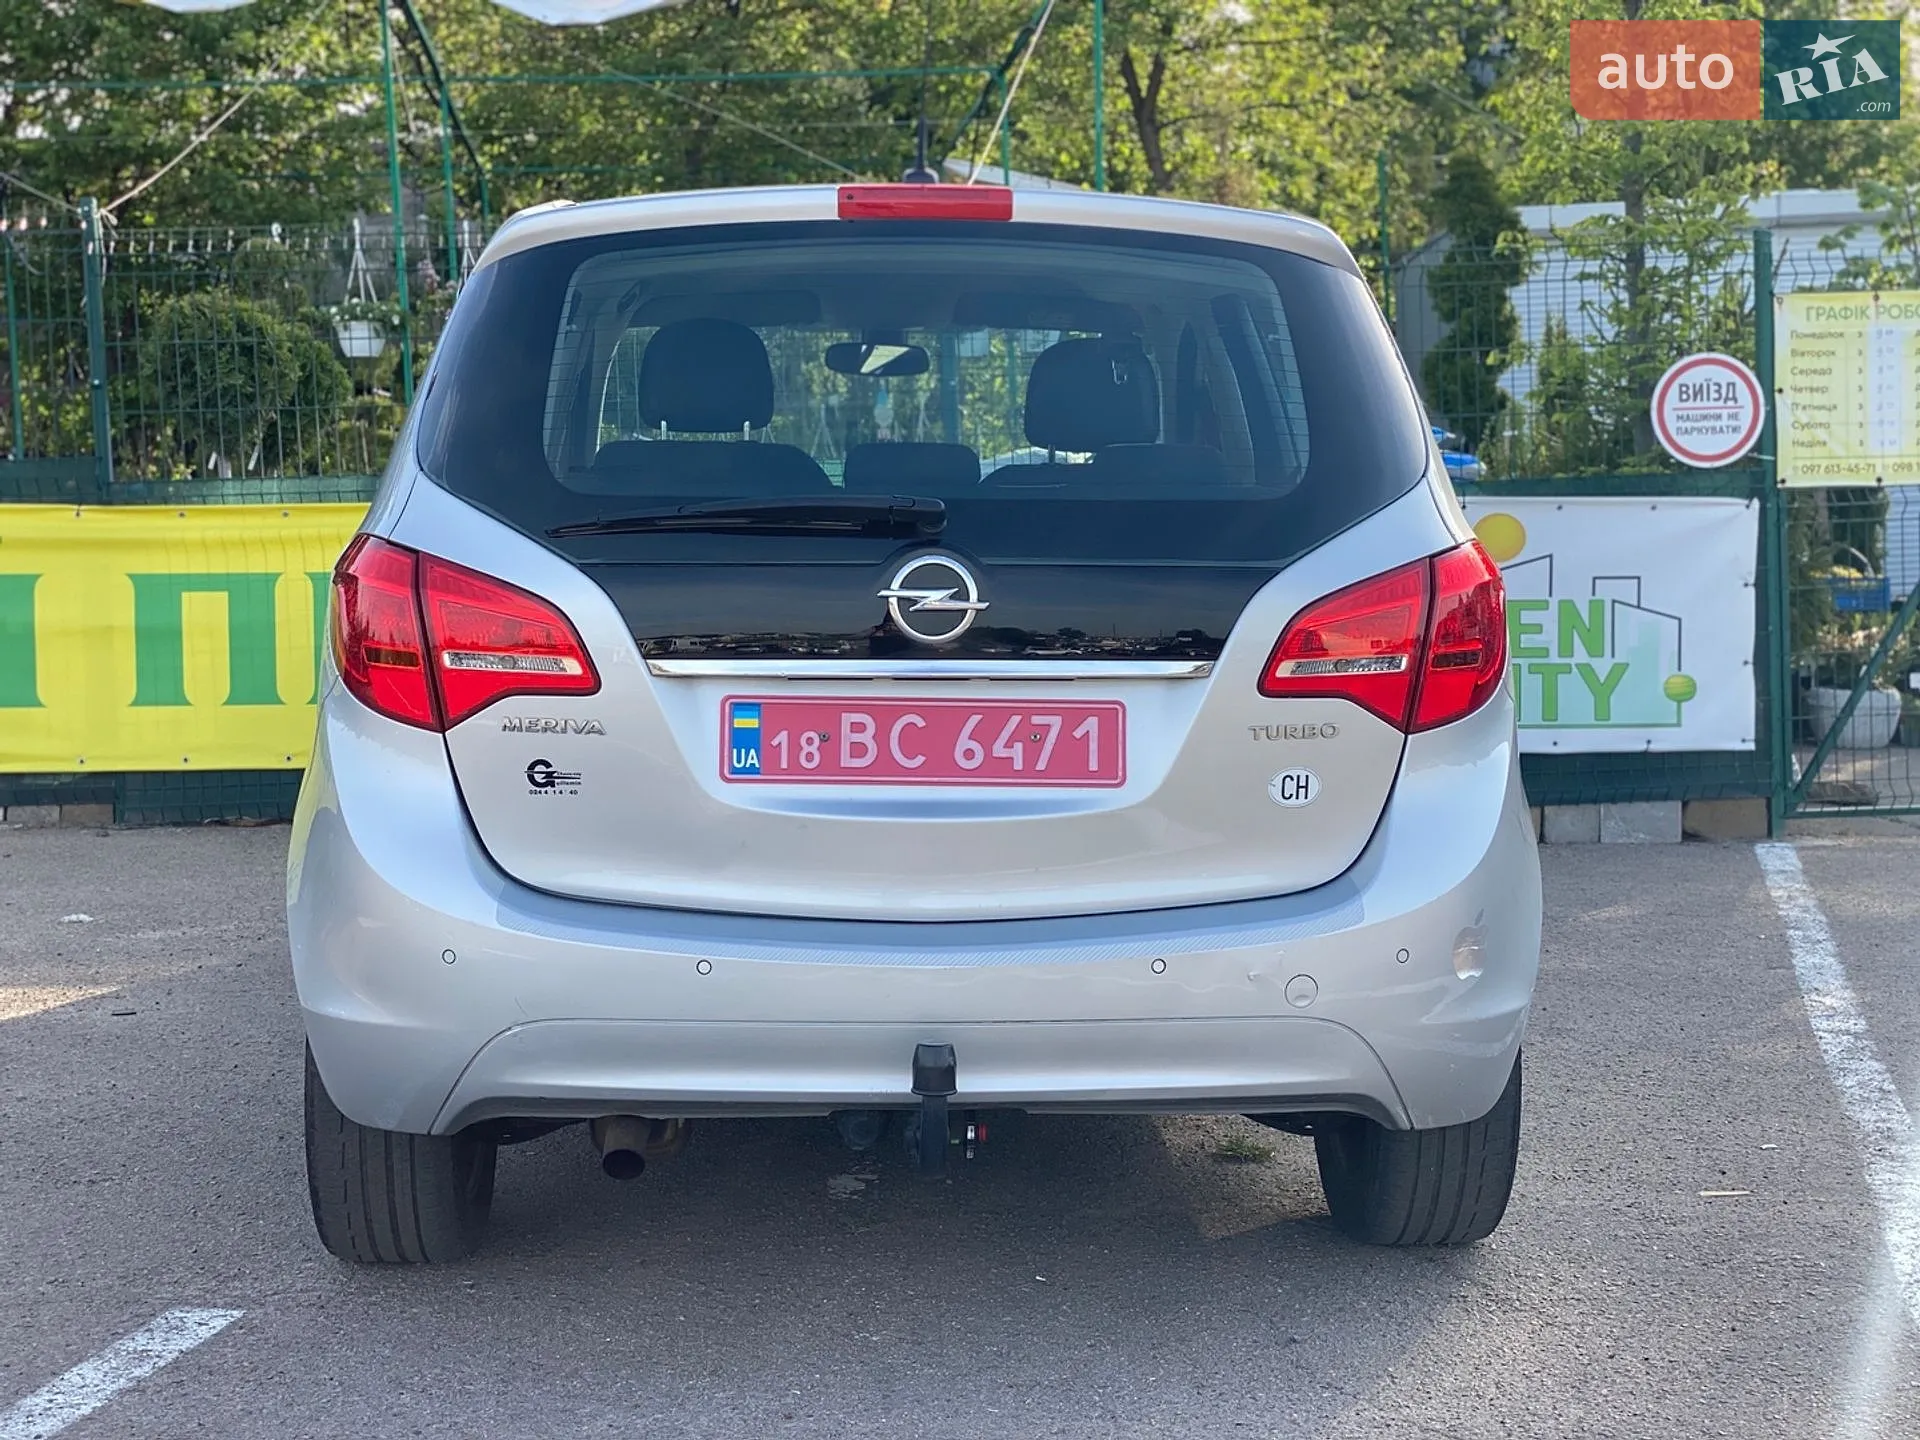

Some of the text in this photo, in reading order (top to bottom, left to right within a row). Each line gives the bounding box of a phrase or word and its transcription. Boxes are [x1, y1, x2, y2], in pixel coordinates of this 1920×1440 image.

[1806, 304, 1870, 322] ГРАФІК
[1790, 330, 1845, 340] Понеділок
[1790, 348, 1836, 359] Вівторок
[1790, 366, 1833, 377] Середа
[1678, 377, 1738, 405] ВИЇЗД
[1790, 384, 1829, 395] Четвер
[1676, 411, 1741, 423] МАШИНИ НЕ
[1791, 420, 1831, 431] Субота
[1792, 438, 1828, 449] Неділя
[1801, 464, 1822, 475] 097
[1507, 598, 1605, 659] EN
[501, 716, 607, 736] MERIVA
[1248, 723, 1340, 741] TURBO
[733, 711, 1100, 772] UA 18 BC 6471
[1281, 774, 1309, 800] CH
